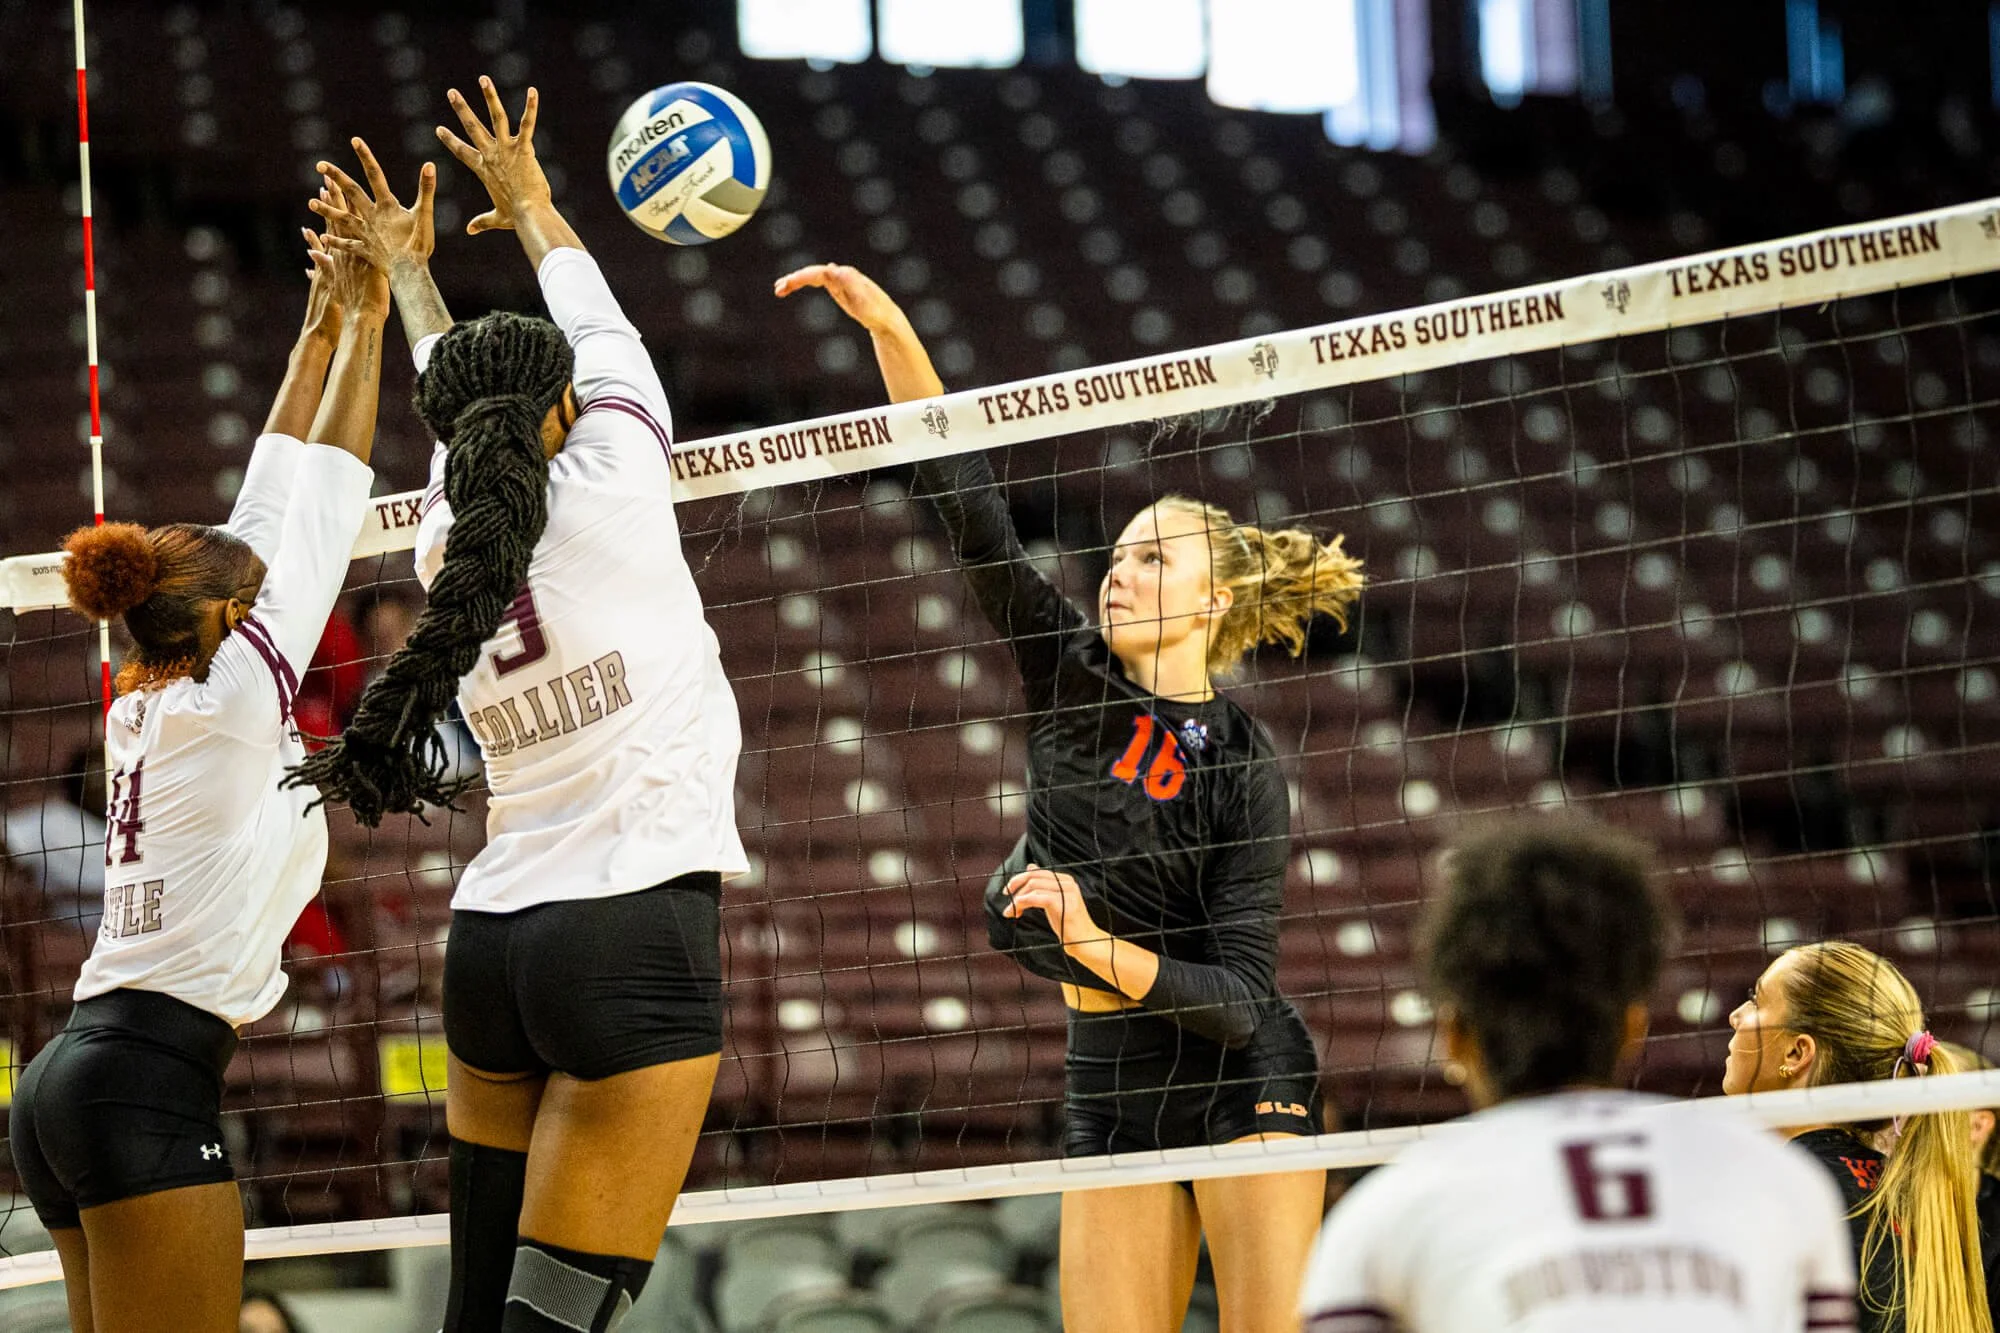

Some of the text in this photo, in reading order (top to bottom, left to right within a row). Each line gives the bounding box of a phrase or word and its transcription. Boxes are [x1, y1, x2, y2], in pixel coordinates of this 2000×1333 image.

[616, 111, 686, 173] molten
[630, 135, 693, 193] NCAA
[1667, 253, 1770, 297] TEXAS
[1777, 221, 1941, 278] SOUTHERN
[1310, 320, 1407, 364] TEXAS
[1414, 290, 1565, 344] SOUTHERN
[978, 382, 1070, 424] TEXAS
[1074, 356, 1217, 407] SOUTHERN
[671, 440, 755, 480] TEXAS
[759, 415, 894, 464] SOUTHERN
[376, 497, 422, 529] TEX
[470, 650, 633, 757] COLLIER
[1111, 714, 1187, 802] 16
[1558, 1132, 1656, 1223] 6
